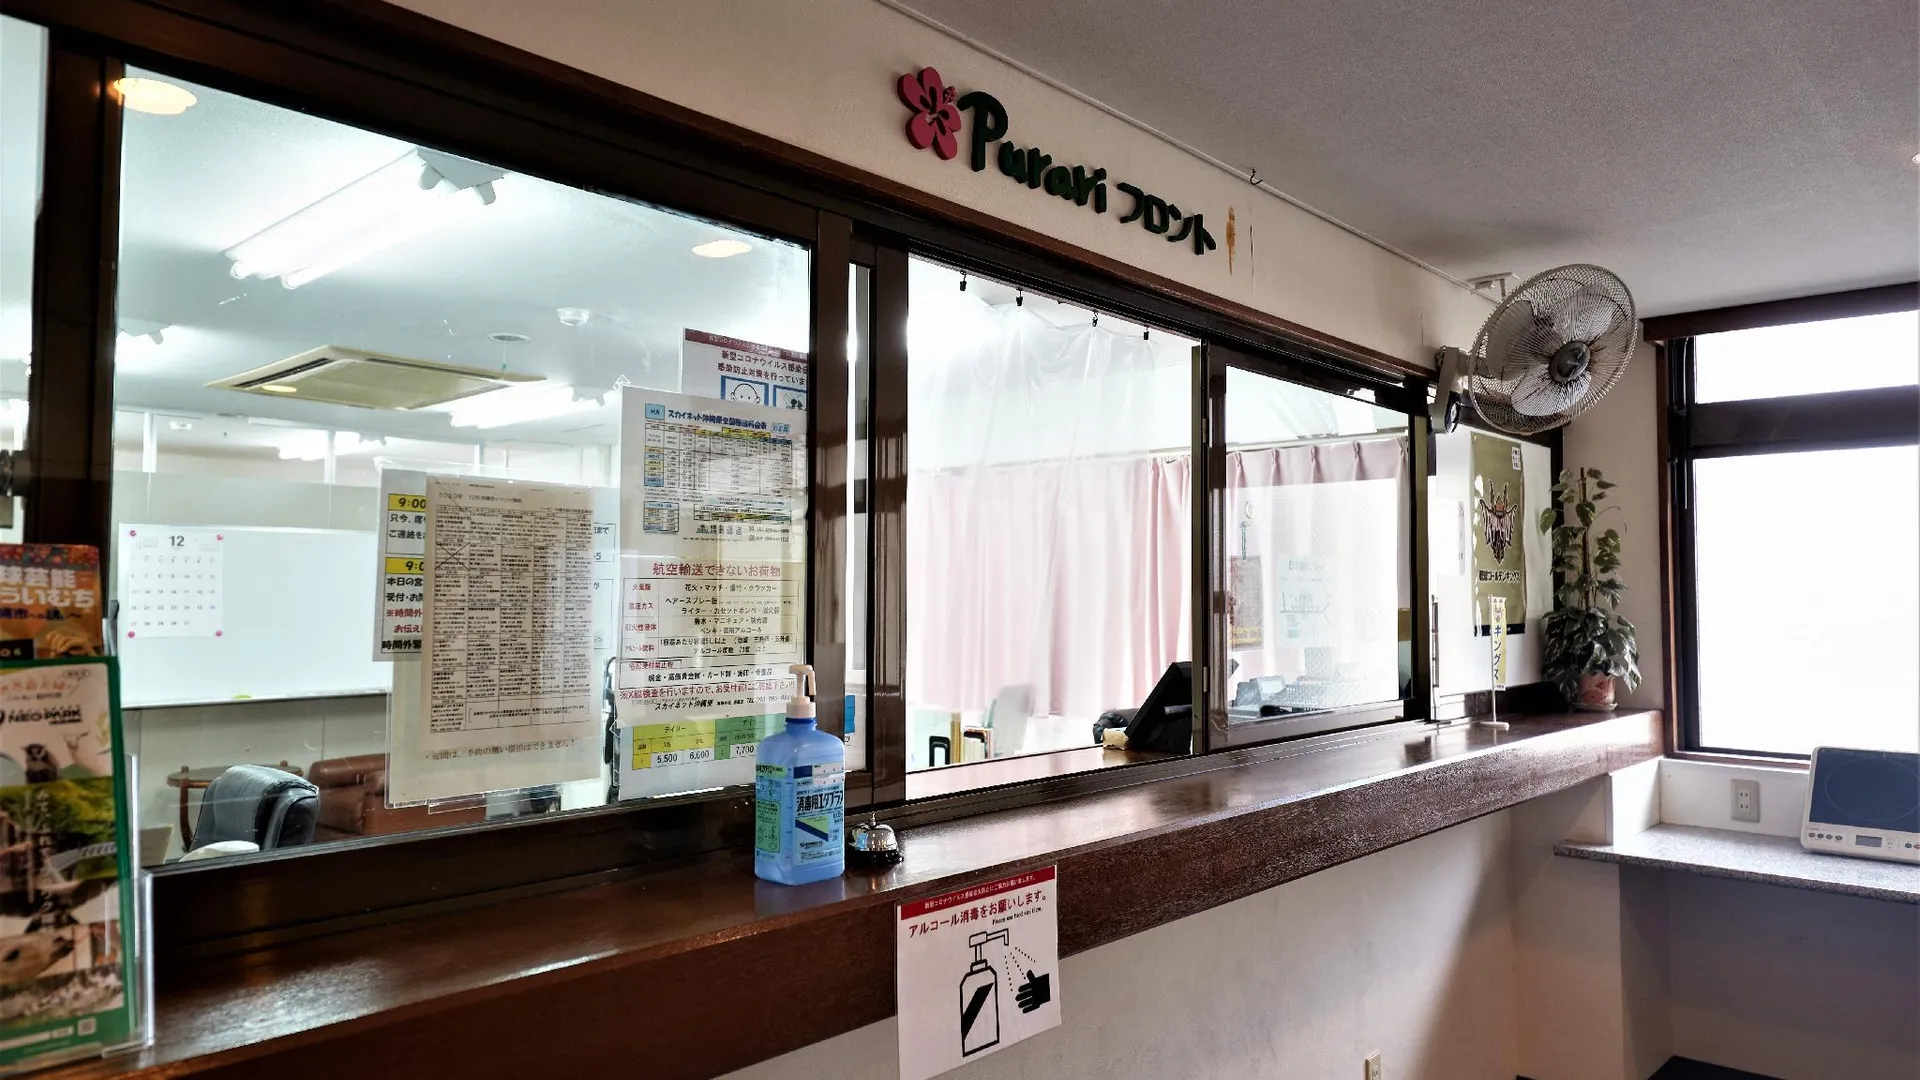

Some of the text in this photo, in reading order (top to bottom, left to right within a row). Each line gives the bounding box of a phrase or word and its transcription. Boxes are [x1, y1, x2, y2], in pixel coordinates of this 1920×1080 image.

[957, 91, 1217, 256] Purari フロント
[168, 535, 185, 547] 12
[652, 562, 781, 577] 航空輸送できないお荷物
[1493, 624, 1502, 681] キングス
[656, 753, 678, 764] 5,500
[909, 890, 1047, 938] アルコール消毒をお願いします。
